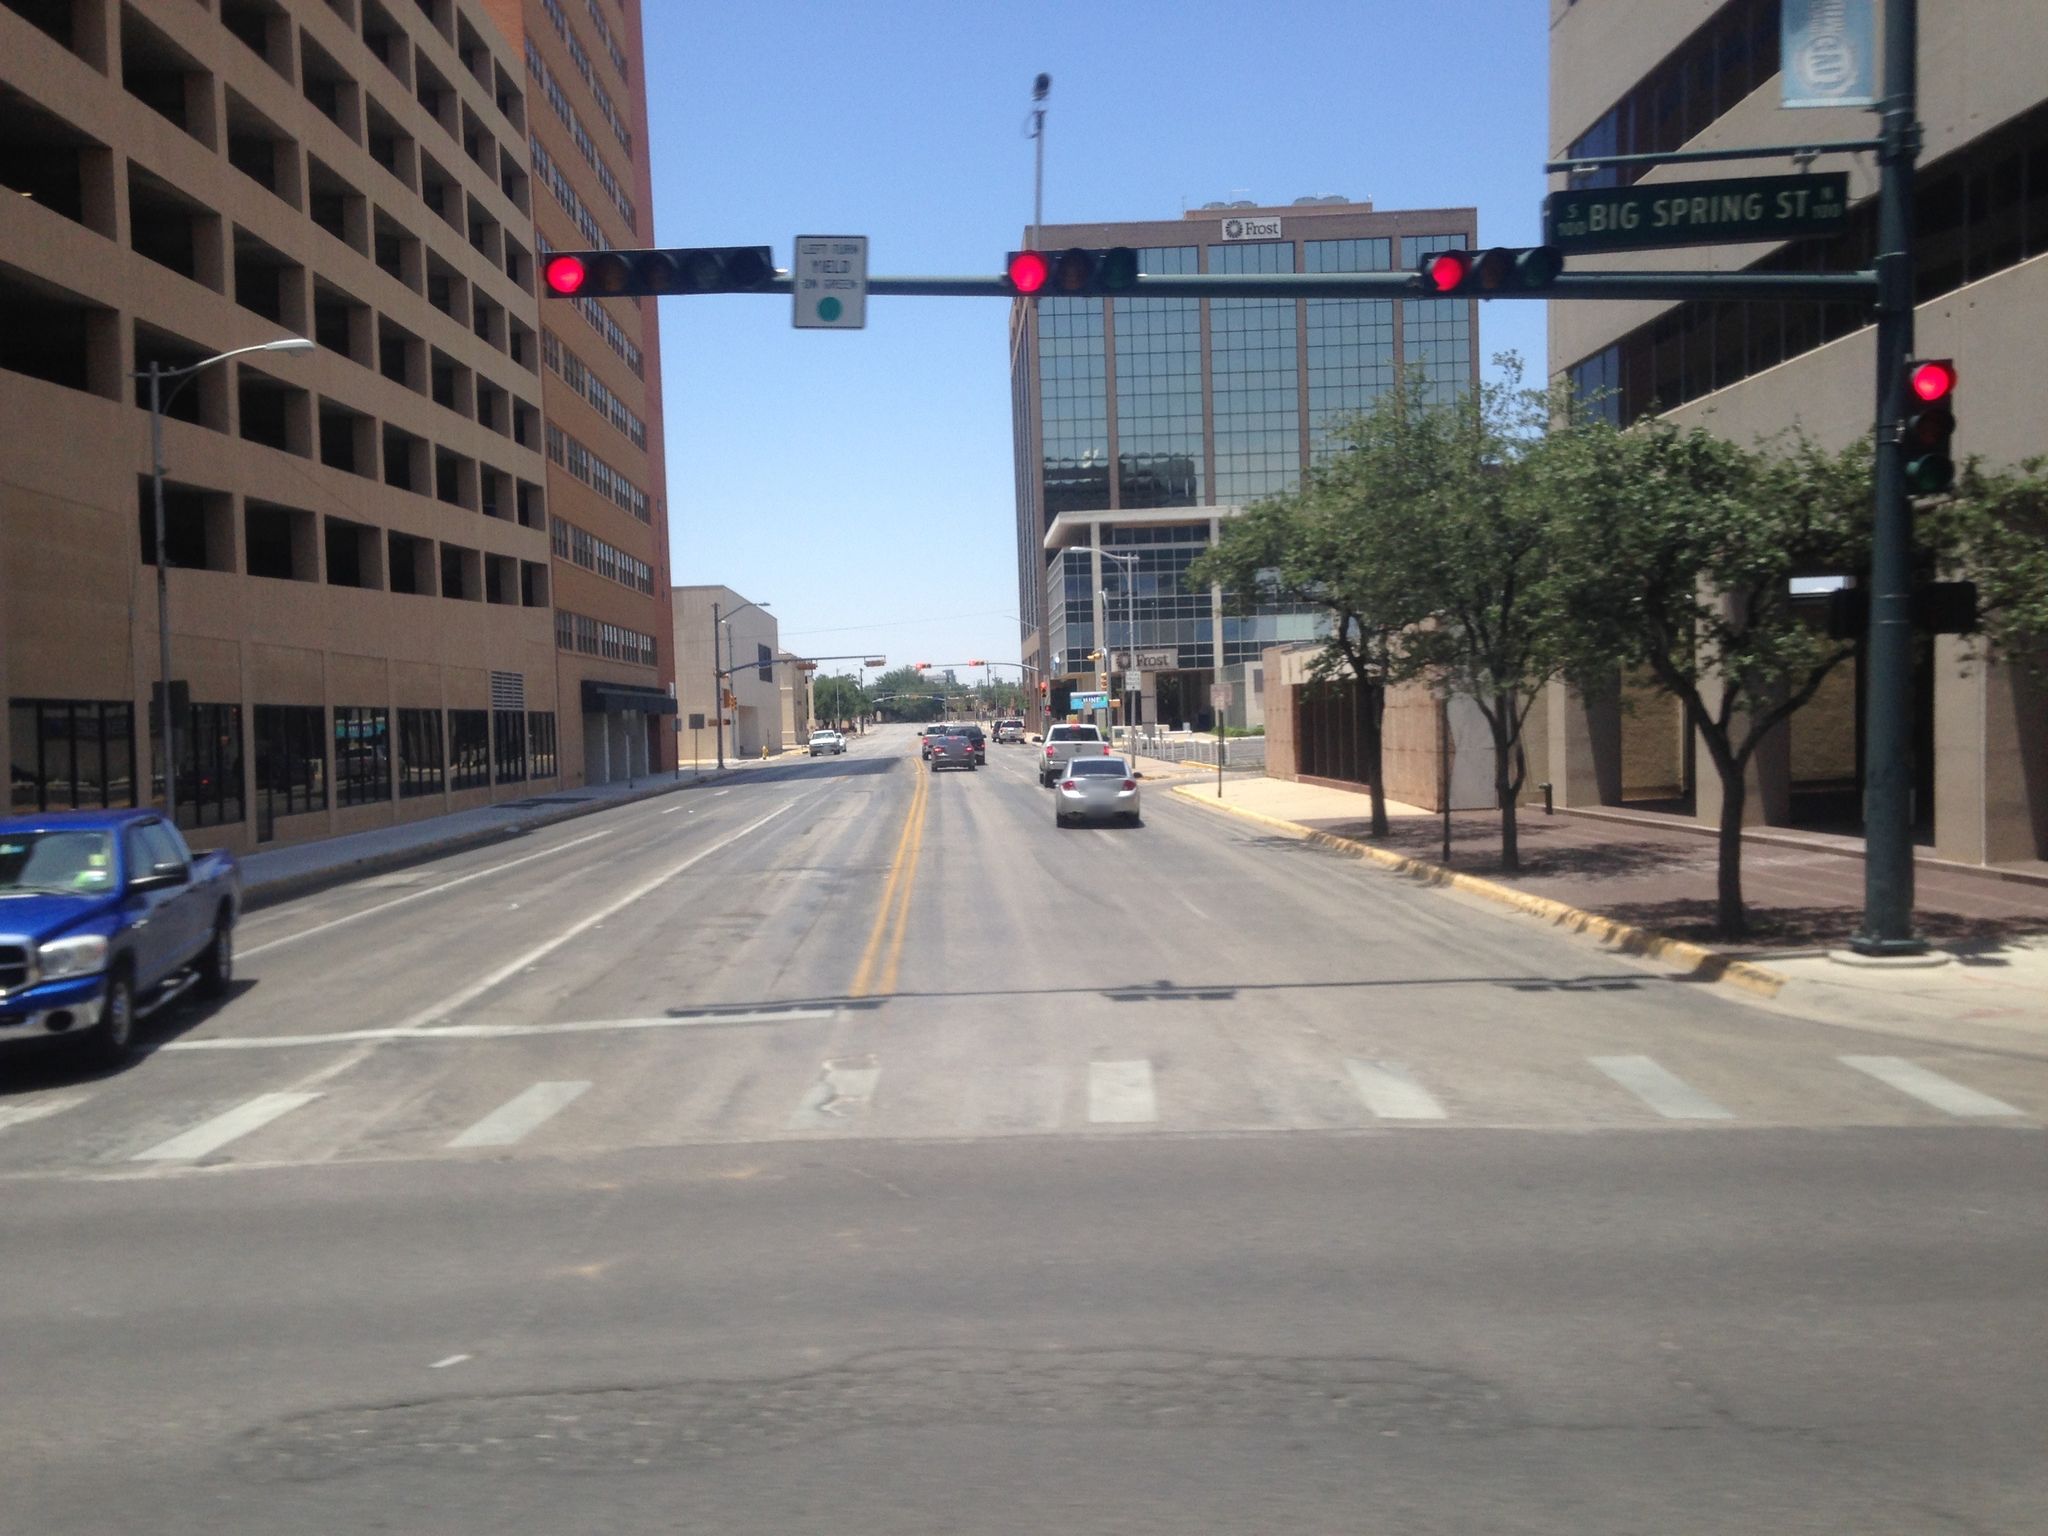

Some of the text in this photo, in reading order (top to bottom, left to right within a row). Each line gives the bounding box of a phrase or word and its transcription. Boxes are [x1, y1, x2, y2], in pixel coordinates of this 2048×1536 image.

[1566, 204, 1579, 218] S
[1589, 190, 1812, 232] BIG SPRING ST
[1245, 221, 1279, 236] Frost
[1135, 652, 1169, 667] Frost
